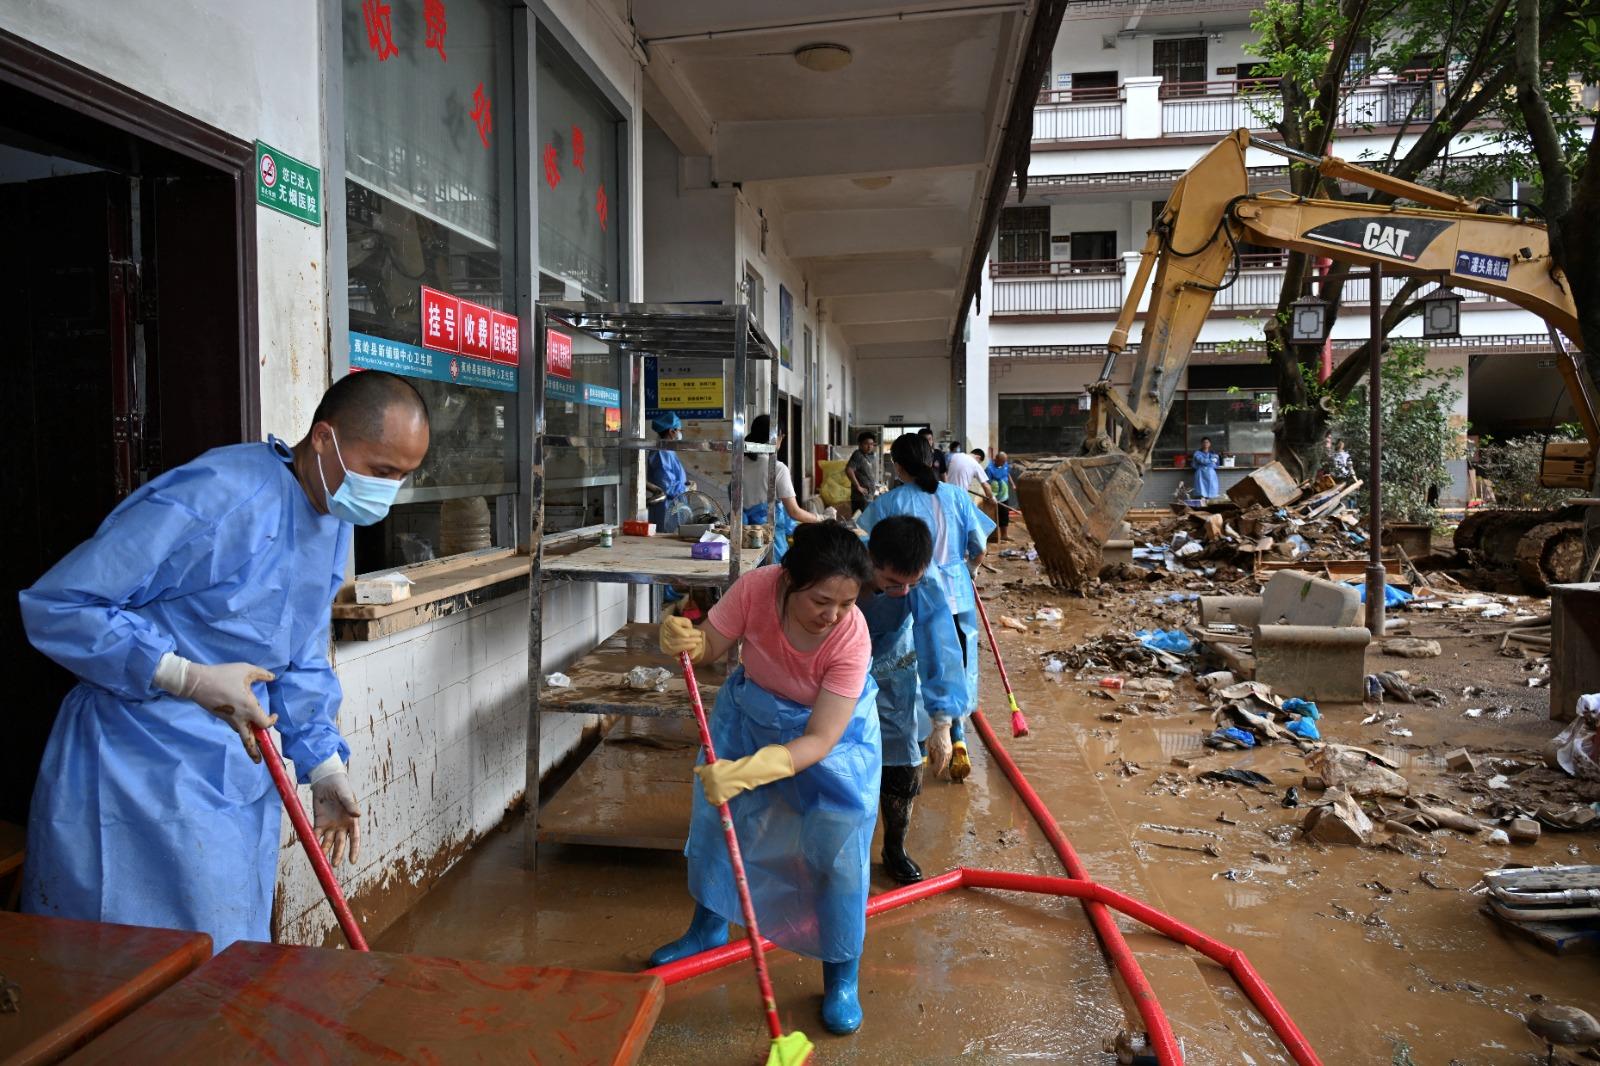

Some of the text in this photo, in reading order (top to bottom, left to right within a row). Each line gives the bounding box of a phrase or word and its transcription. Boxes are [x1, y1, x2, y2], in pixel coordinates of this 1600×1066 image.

[282, 167, 313, 192] 您已进入
[278, 183, 317, 213] 无烟医院
[1362, 222, 1411, 257] CAT
[428, 301, 455, 341] 挂号
[464, 313, 487, 348] 收费
[493, 322, 518, 355] 医保结算
